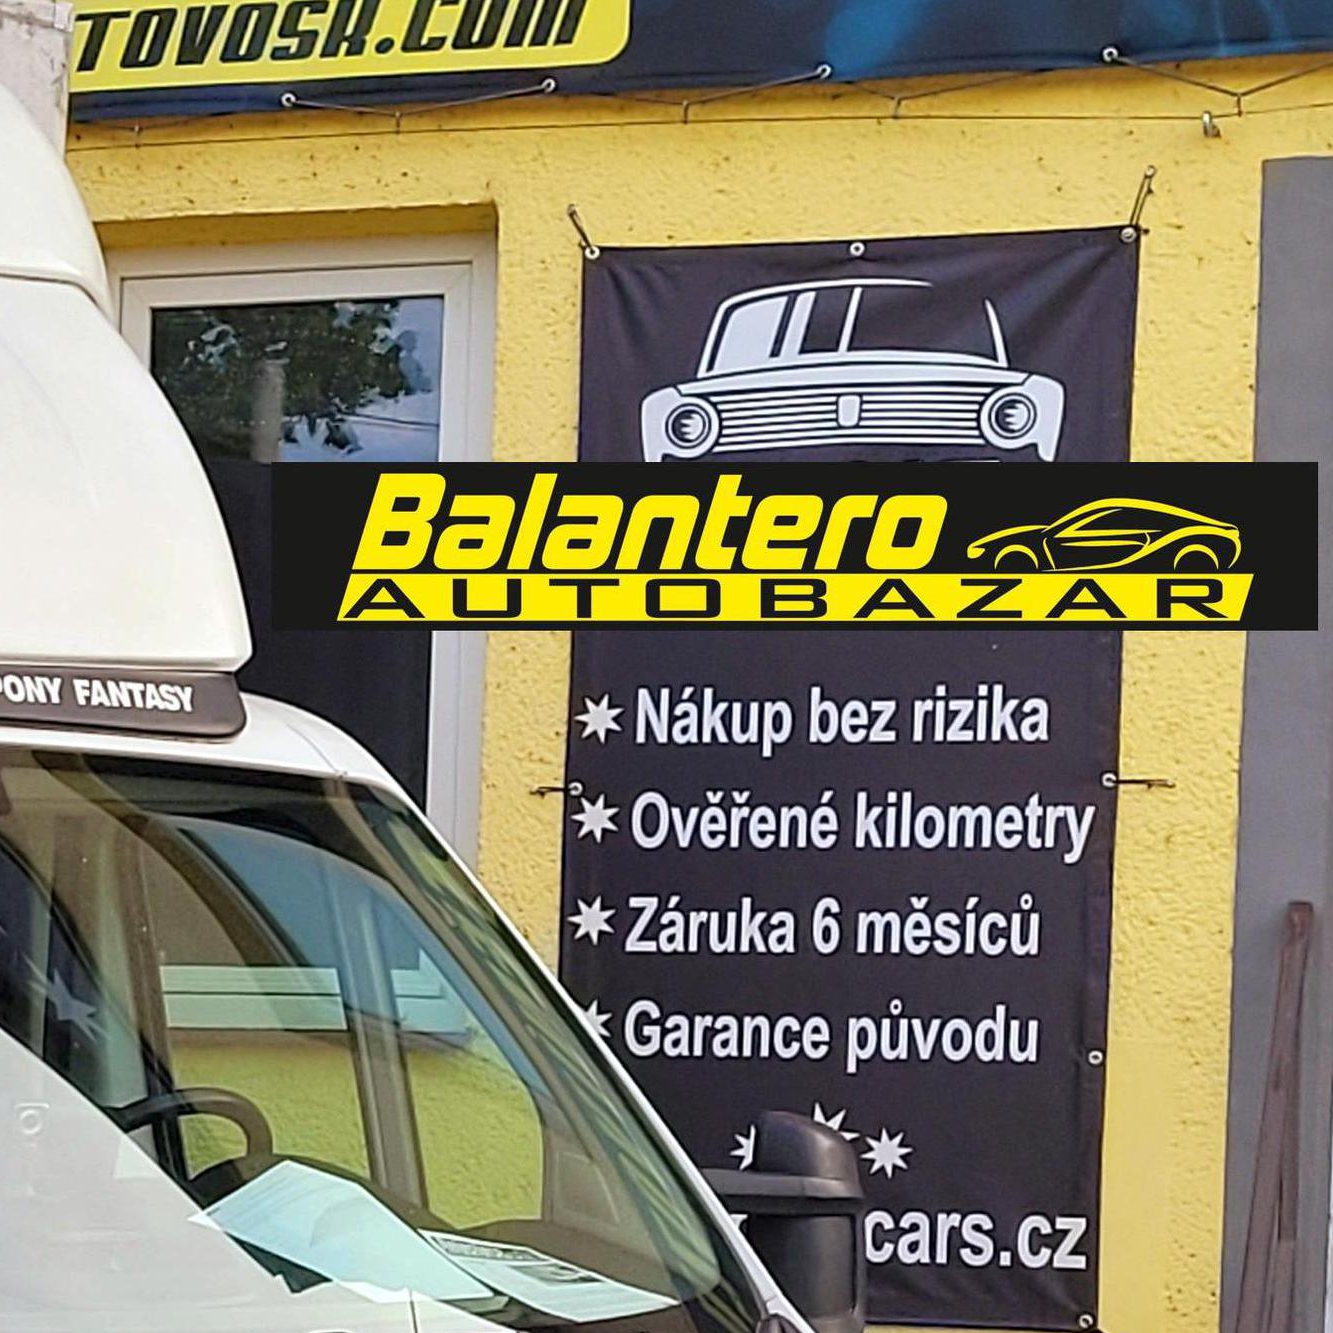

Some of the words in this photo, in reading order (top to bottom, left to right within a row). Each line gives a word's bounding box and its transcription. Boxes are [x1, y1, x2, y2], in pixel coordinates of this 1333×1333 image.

[73, 679, 193, 712] FANTASY
[634, 686, 793, 756] Nákup
[808, 686, 897, 744] bez
[911, 684, 1050, 744] rizika
[630, 790, 840, 851] Ověřené
[854, 793, 1096, 864] kilometry
[624, 895, 796, 954] Záruka
[811, 897, 841, 955] 6
[855, 893, 1040, 957] měsíců
[623, 1000, 829, 1059] Garance
[846, 999, 1039, 1073] původu
